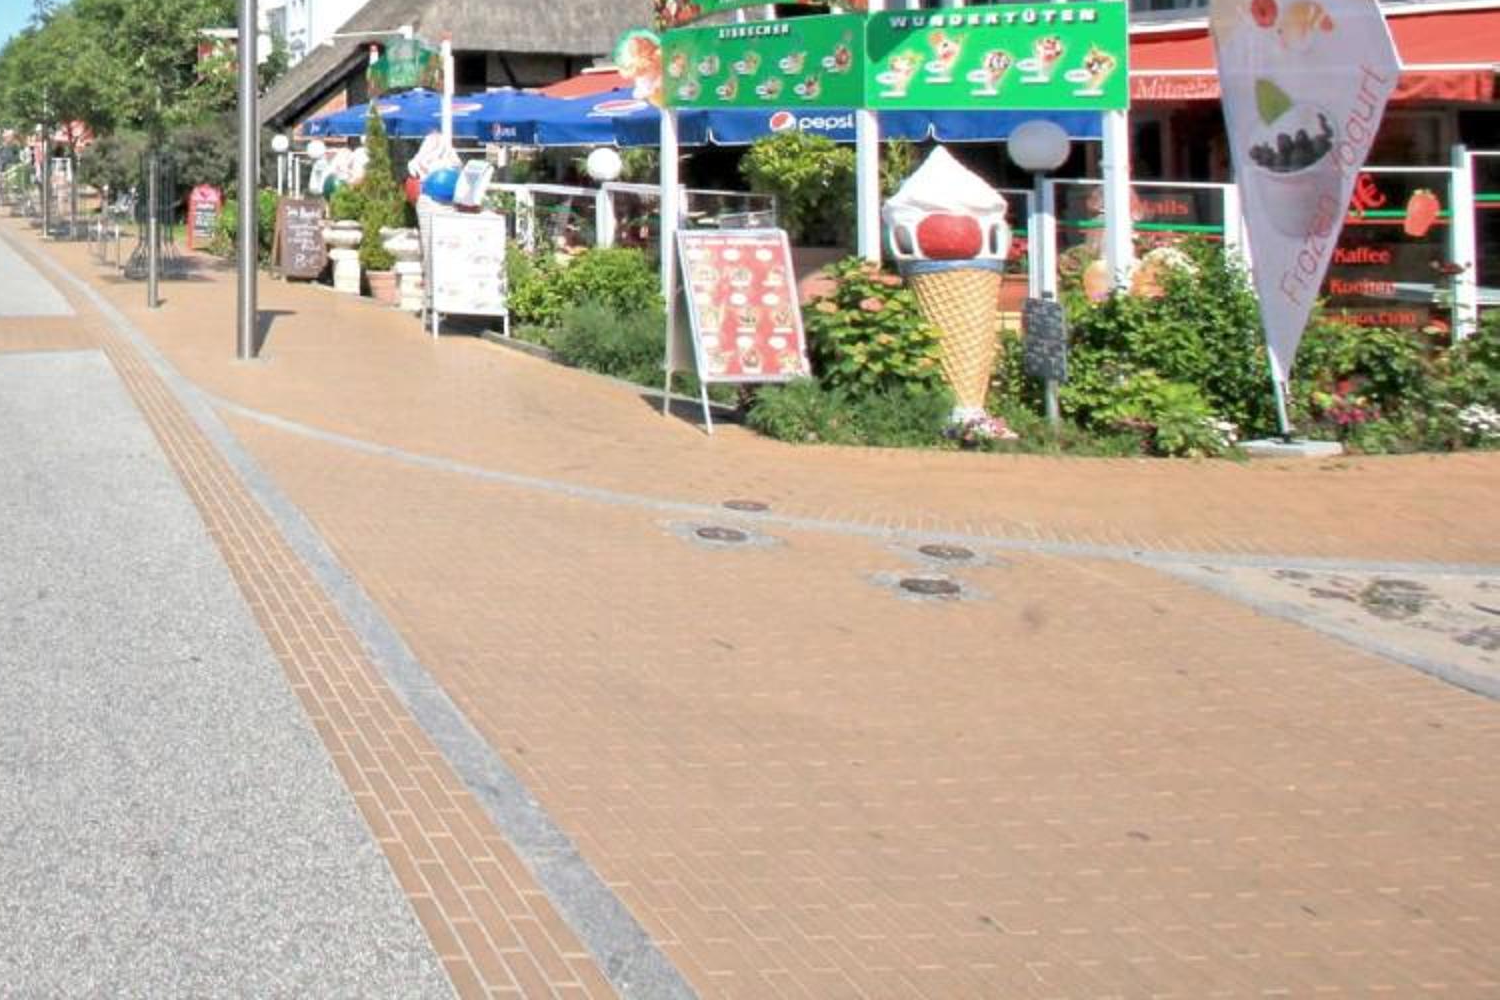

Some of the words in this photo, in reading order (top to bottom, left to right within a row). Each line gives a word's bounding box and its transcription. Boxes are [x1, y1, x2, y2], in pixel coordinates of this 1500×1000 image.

[890, 8, 1097, 28] WUNDERTÜTEN
[719, 24, 790, 40] EISBECHER
[799, 113, 854, 130] pepsi
[1279, 190, 1334, 307] Frozen
[1333, 247, 1392, 264] Kaffee
